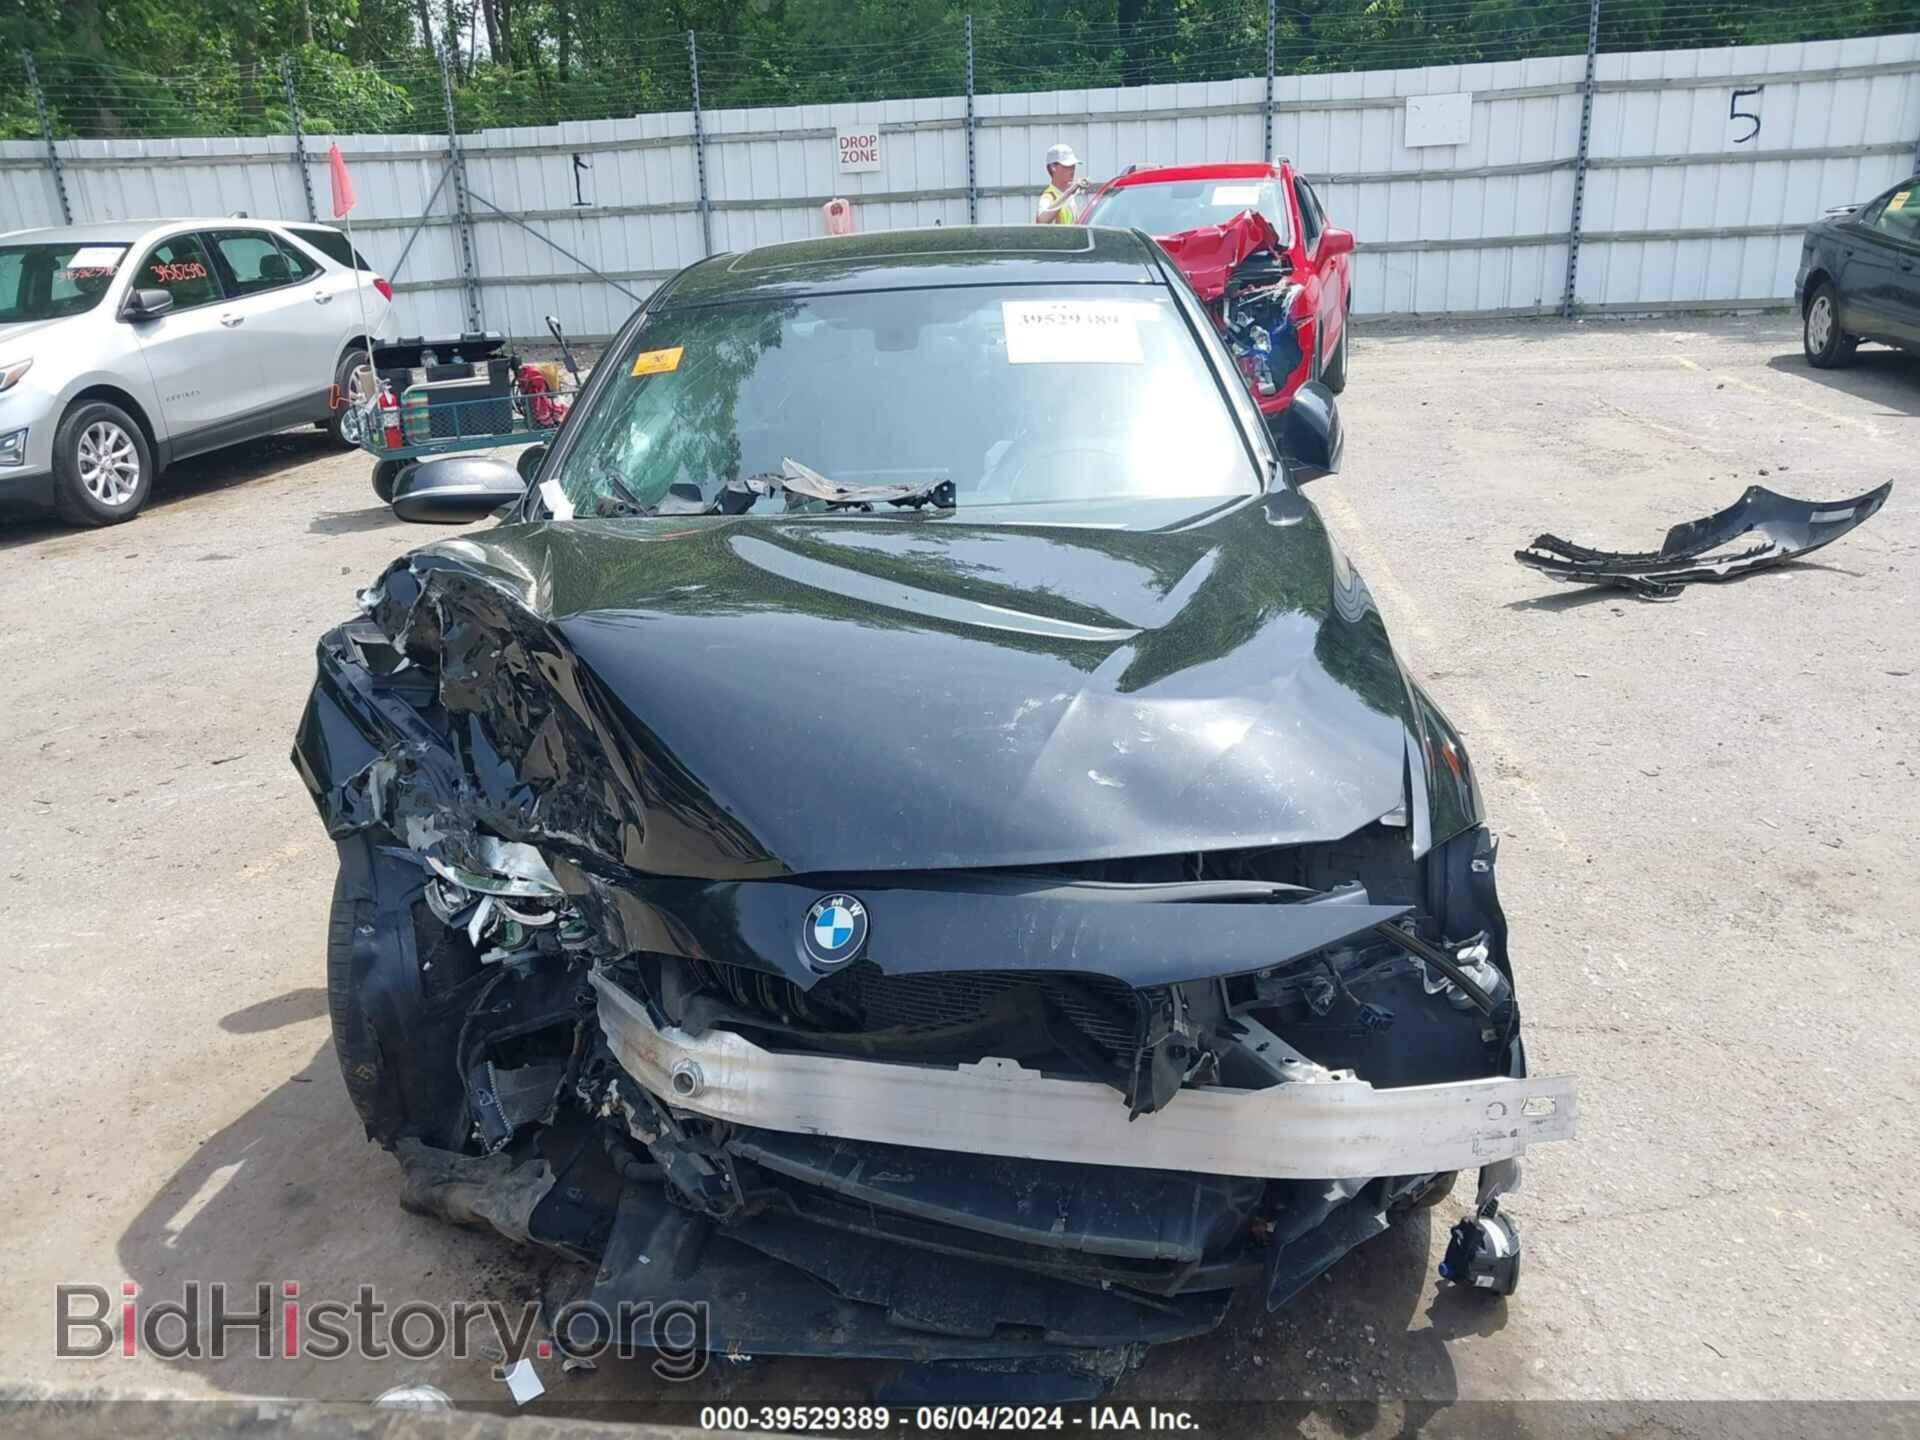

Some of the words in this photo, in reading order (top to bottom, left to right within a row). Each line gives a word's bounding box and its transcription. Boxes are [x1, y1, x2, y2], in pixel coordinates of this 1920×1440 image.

[1730, 84, 1765, 143] 5
[840, 134, 877, 149] DROP
[840, 149, 878, 163] ZONE
[812, 897, 863, 918] BMW
